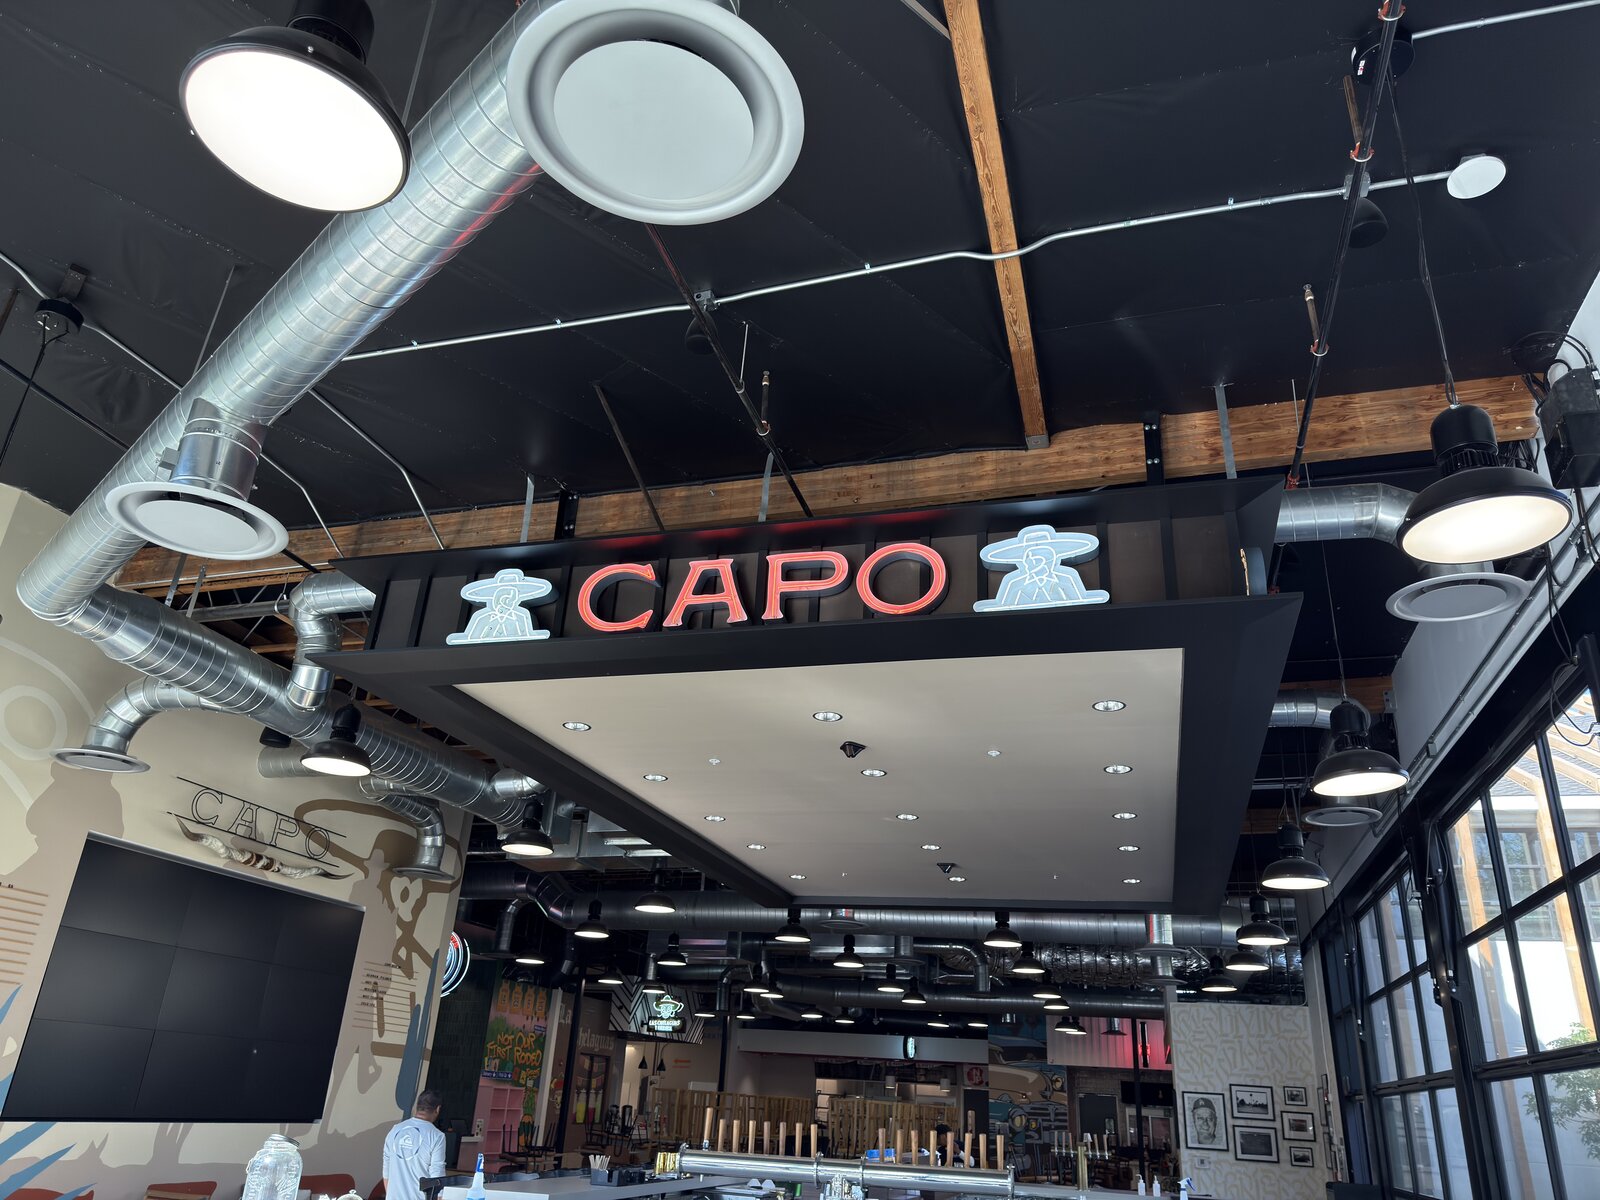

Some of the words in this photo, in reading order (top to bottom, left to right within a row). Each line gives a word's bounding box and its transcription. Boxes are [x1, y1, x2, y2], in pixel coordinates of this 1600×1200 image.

[577, 542, 948, 632] CAPO
[191, 788, 330, 860] CAPO
[497, 1032, 514, 1048] NOT
[516, 1031, 536, 1050] OUR
[576, 1027, 614, 1051] helaguas
[487, 1041, 511, 1060] FIRST
[514, 1046, 542, 1066] RODEO
